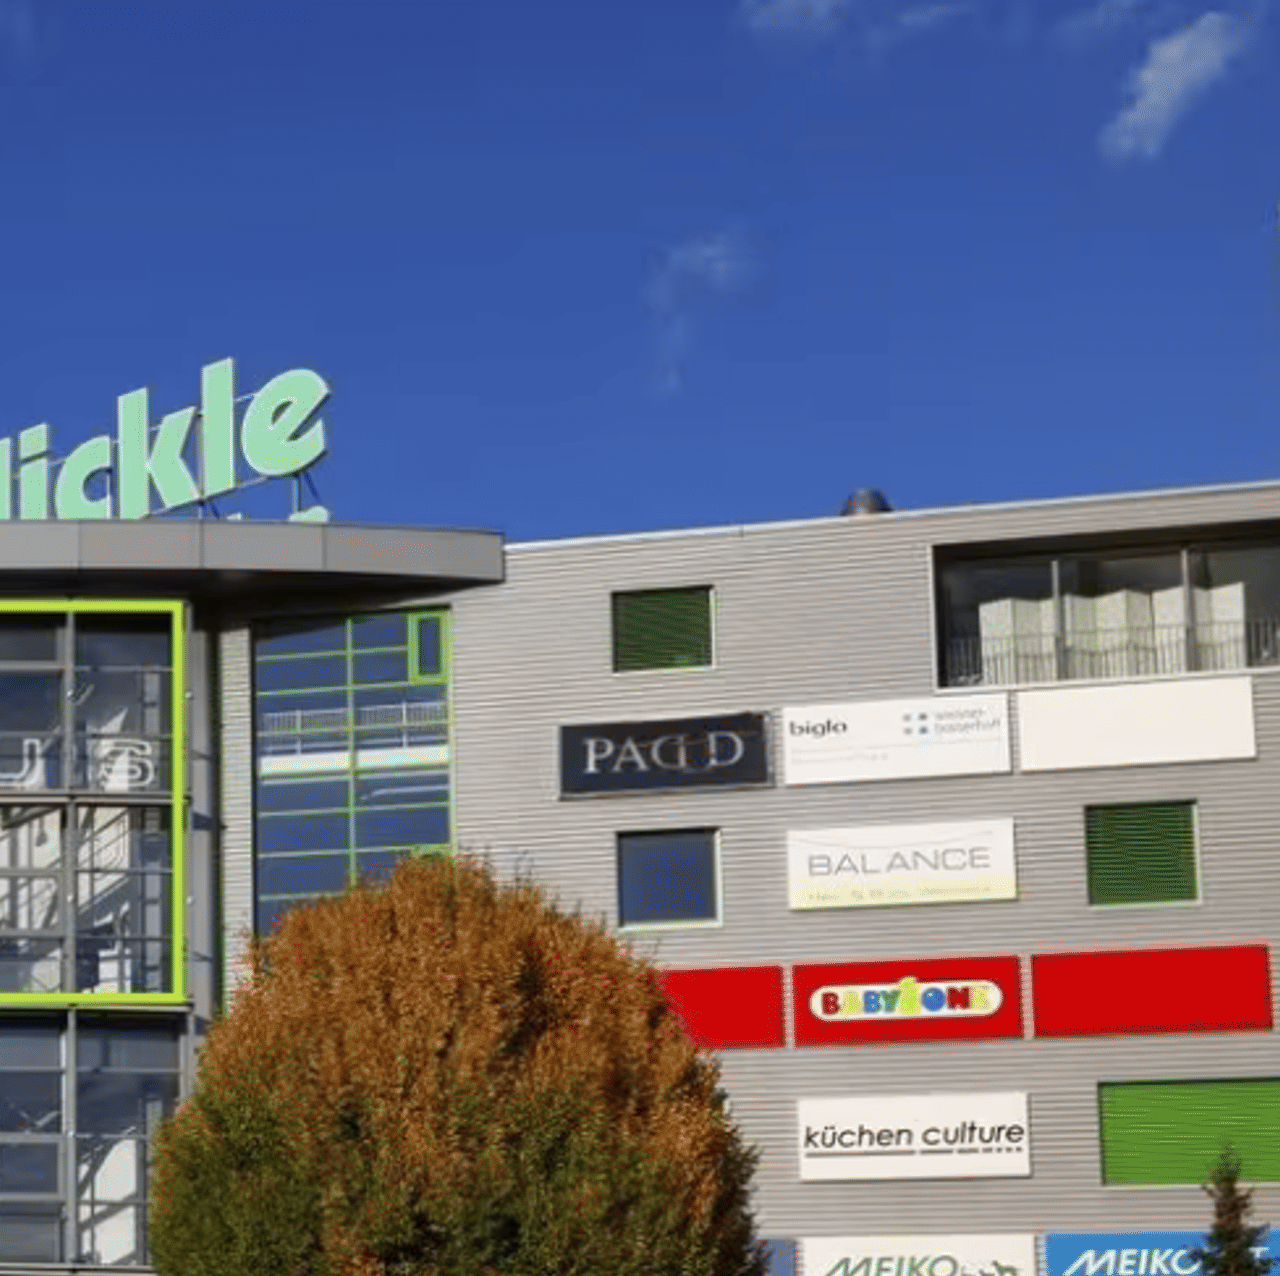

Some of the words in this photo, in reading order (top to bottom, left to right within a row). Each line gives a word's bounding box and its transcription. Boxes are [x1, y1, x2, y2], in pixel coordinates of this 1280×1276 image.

[806, 845, 992, 878] BALANCE
[805, 1124, 914, 1150] küchen
[922, 1120, 1025, 1146] culture
